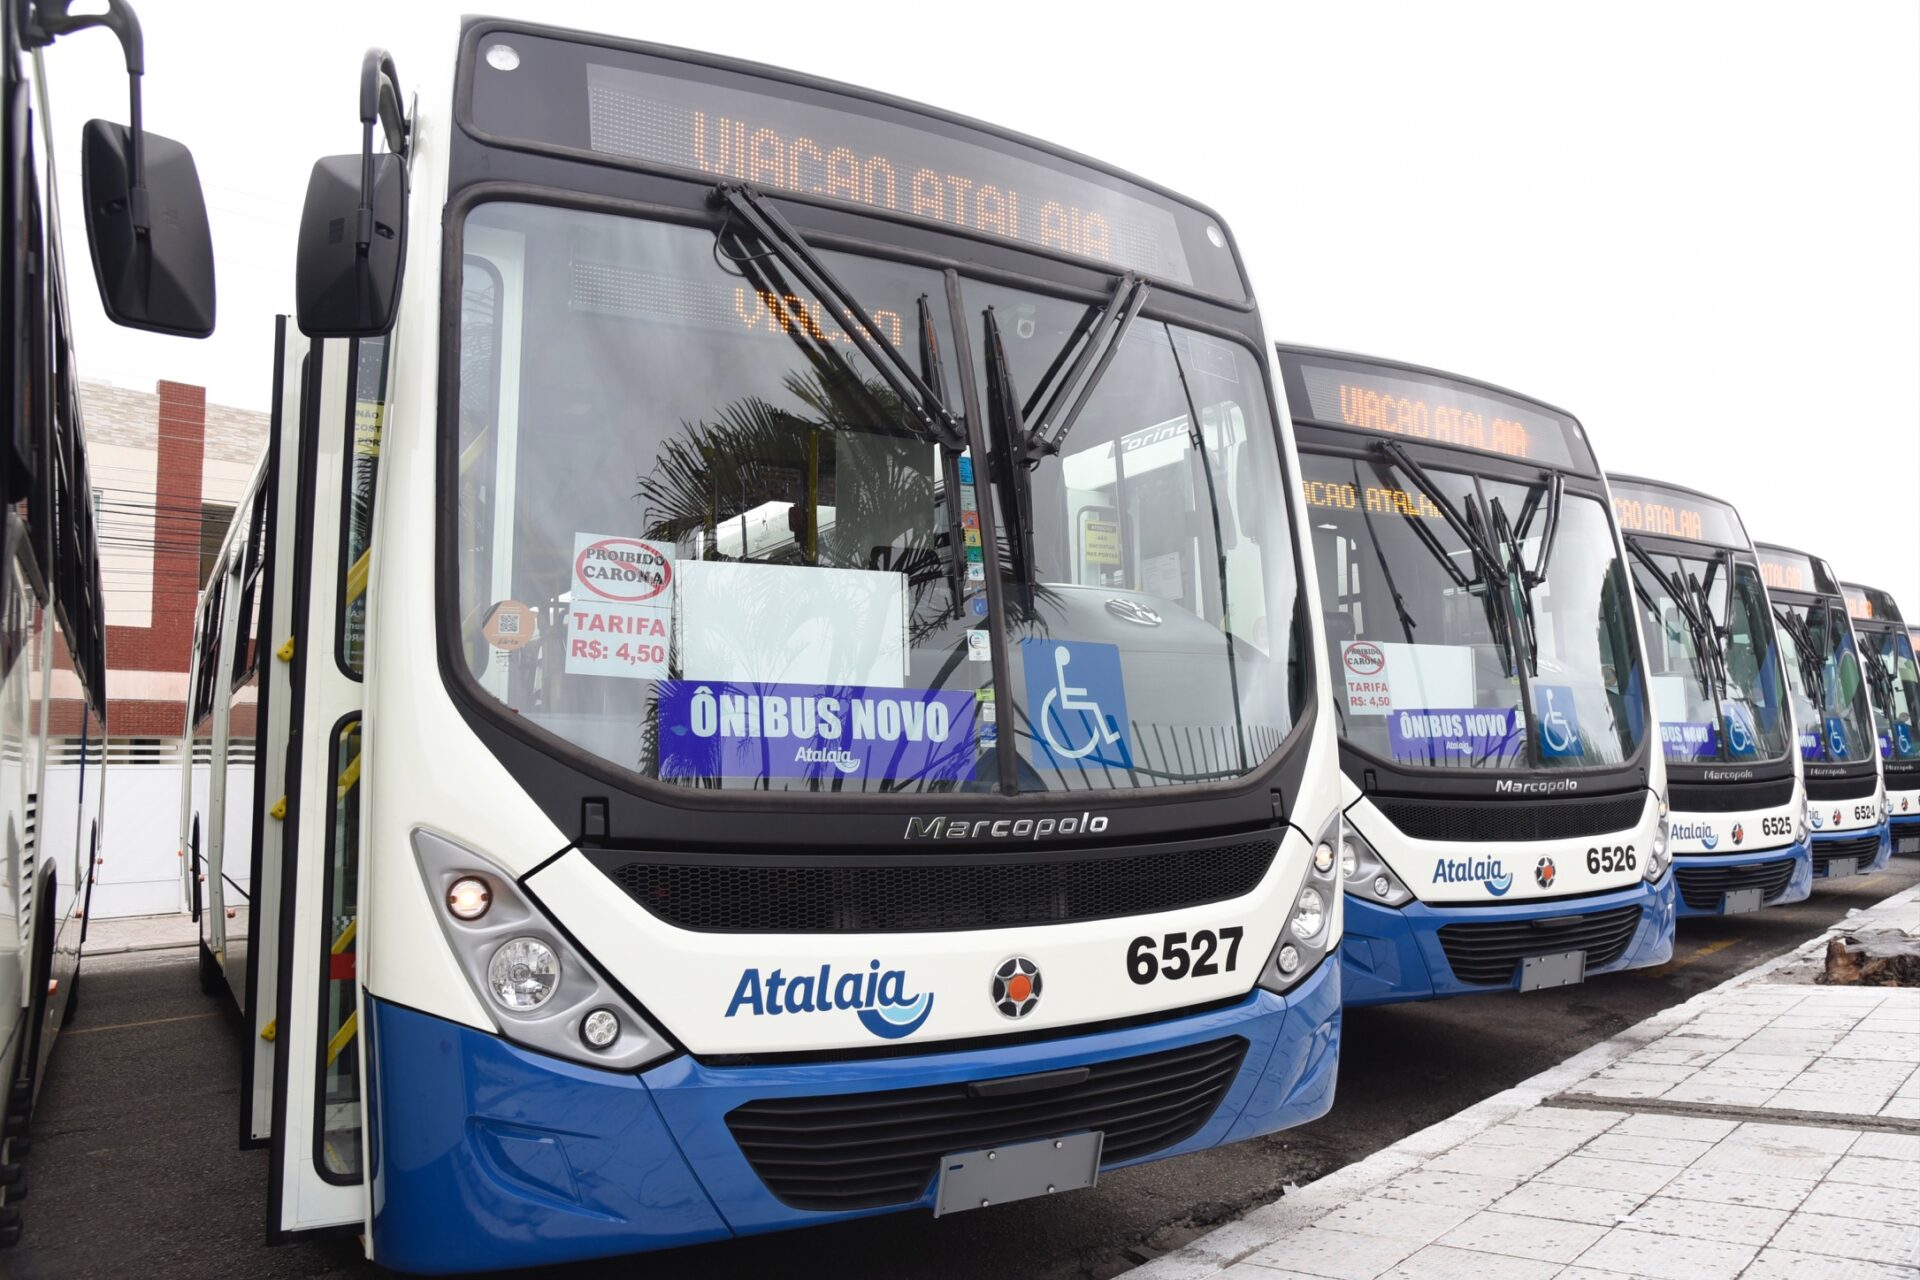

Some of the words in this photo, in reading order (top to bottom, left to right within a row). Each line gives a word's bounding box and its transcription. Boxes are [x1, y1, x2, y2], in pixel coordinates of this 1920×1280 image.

[585, 547, 665, 566] PROIBIDO
[583, 565, 662, 585] CARONA
[573, 612, 666, 637] TARIFA
[571, 638, 608, 660] R$:
[615, 642, 665, 665] 4,50
[1347, 657, 1382, 667] CARONA
[1348, 682, 1389, 693] TARIFA
[1369, 696, 1390, 709] 4,50
[690, 686, 843, 740] ÔNIBUS
[851, 698, 950, 743] NOVO
[1400, 711, 1463, 739] ÔNIBUS
[1465, 714, 1507, 737] NOVO
[1660, 726, 1683, 743] BUS
[1682, 726, 1709, 743] NOVO
[795, 746, 853, 764] Atalaia
[1703, 769, 1753, 781] Marcopolo
[1495, 778, 1578, 794] Marcopolo
[1854, 805, 1876, 821] 6524
[904, 812, 1109, 841] Marcopolo
[1670, 821, 1715, 840] Atalaia
[1762, 816, 1792, 836] 6525
[1432, 854, 1507, 884] Atalaia
[1586, 845, 1637, 874] 6526
[724, 959, 922, 1018] Atalaia
[1125, 926, 1245, 985] 6527
